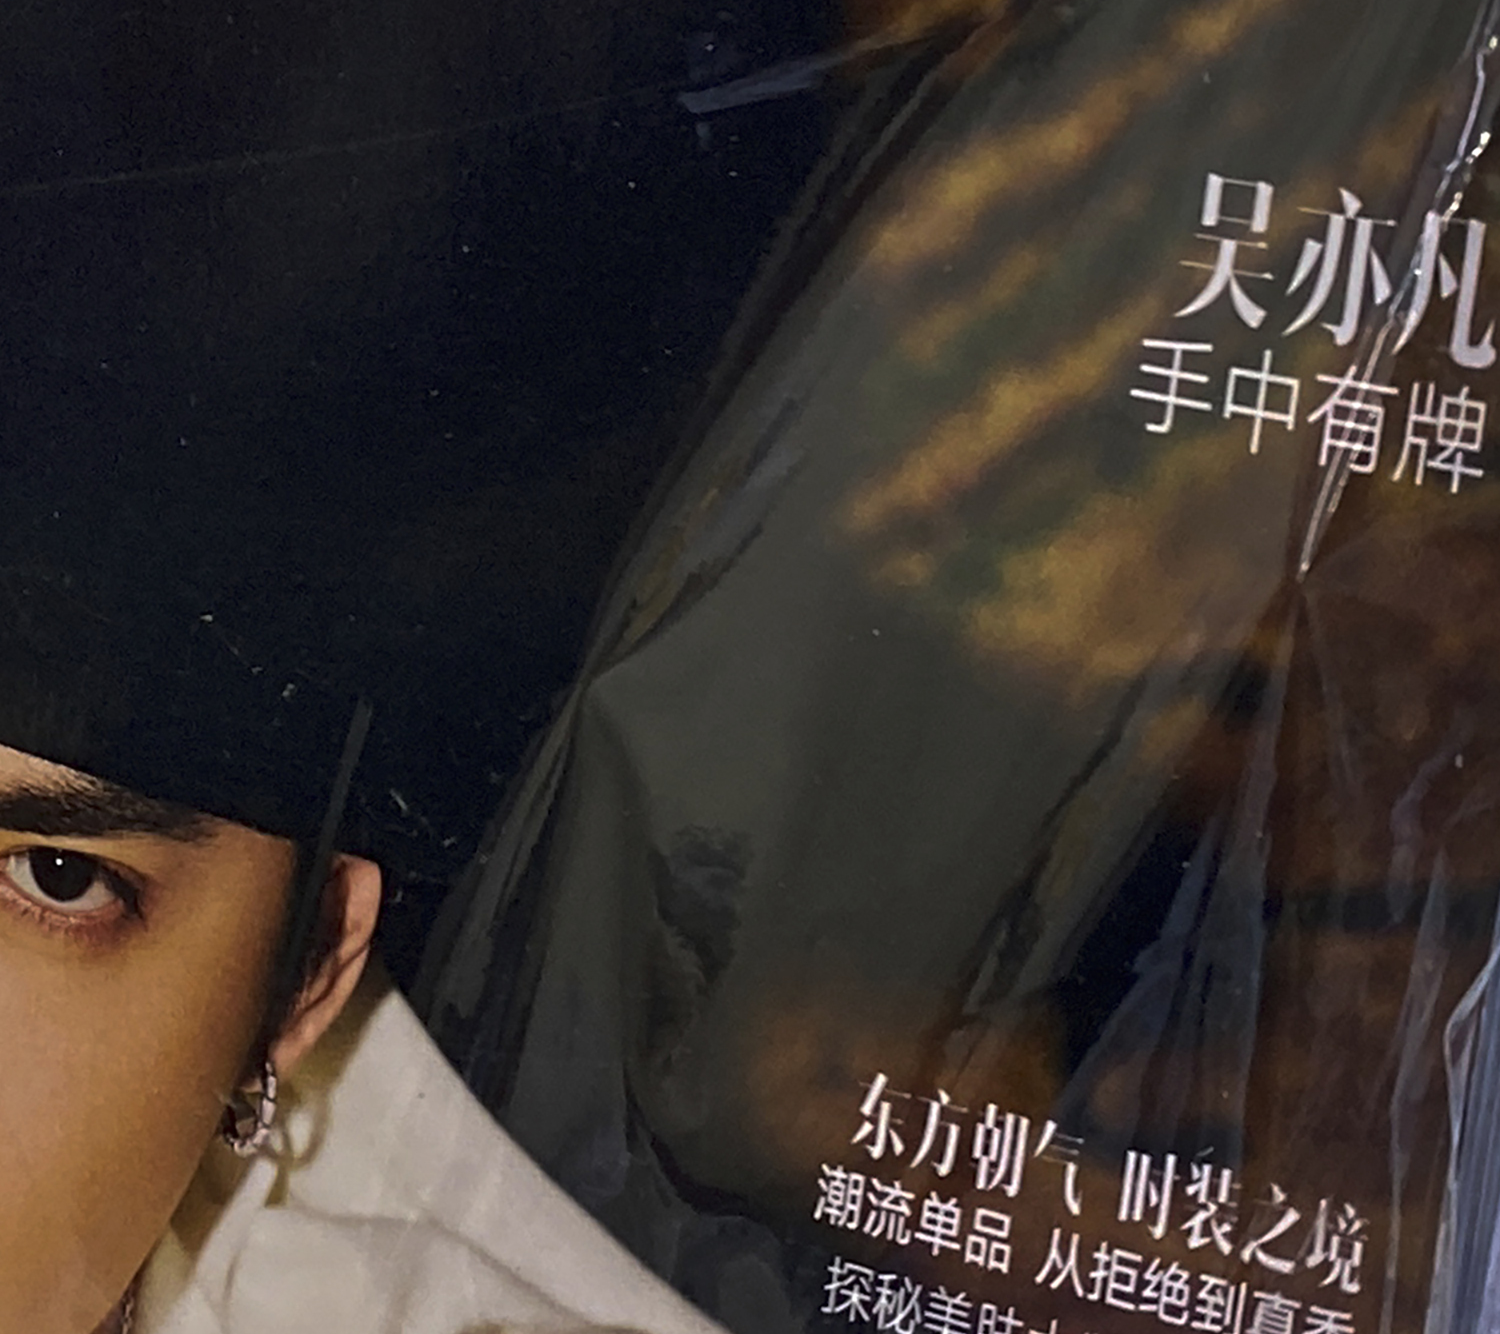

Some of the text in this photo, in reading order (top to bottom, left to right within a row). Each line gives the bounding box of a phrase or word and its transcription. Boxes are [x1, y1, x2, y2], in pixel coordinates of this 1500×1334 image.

[1173, 172, 1498, 368] 吴亦凡
[1129, 338, 1489, 494] 手中有牌
[812, 1162, 1014, 1273] 潮流单品
[850, 1071, 1086, 1216] 东方朝气
